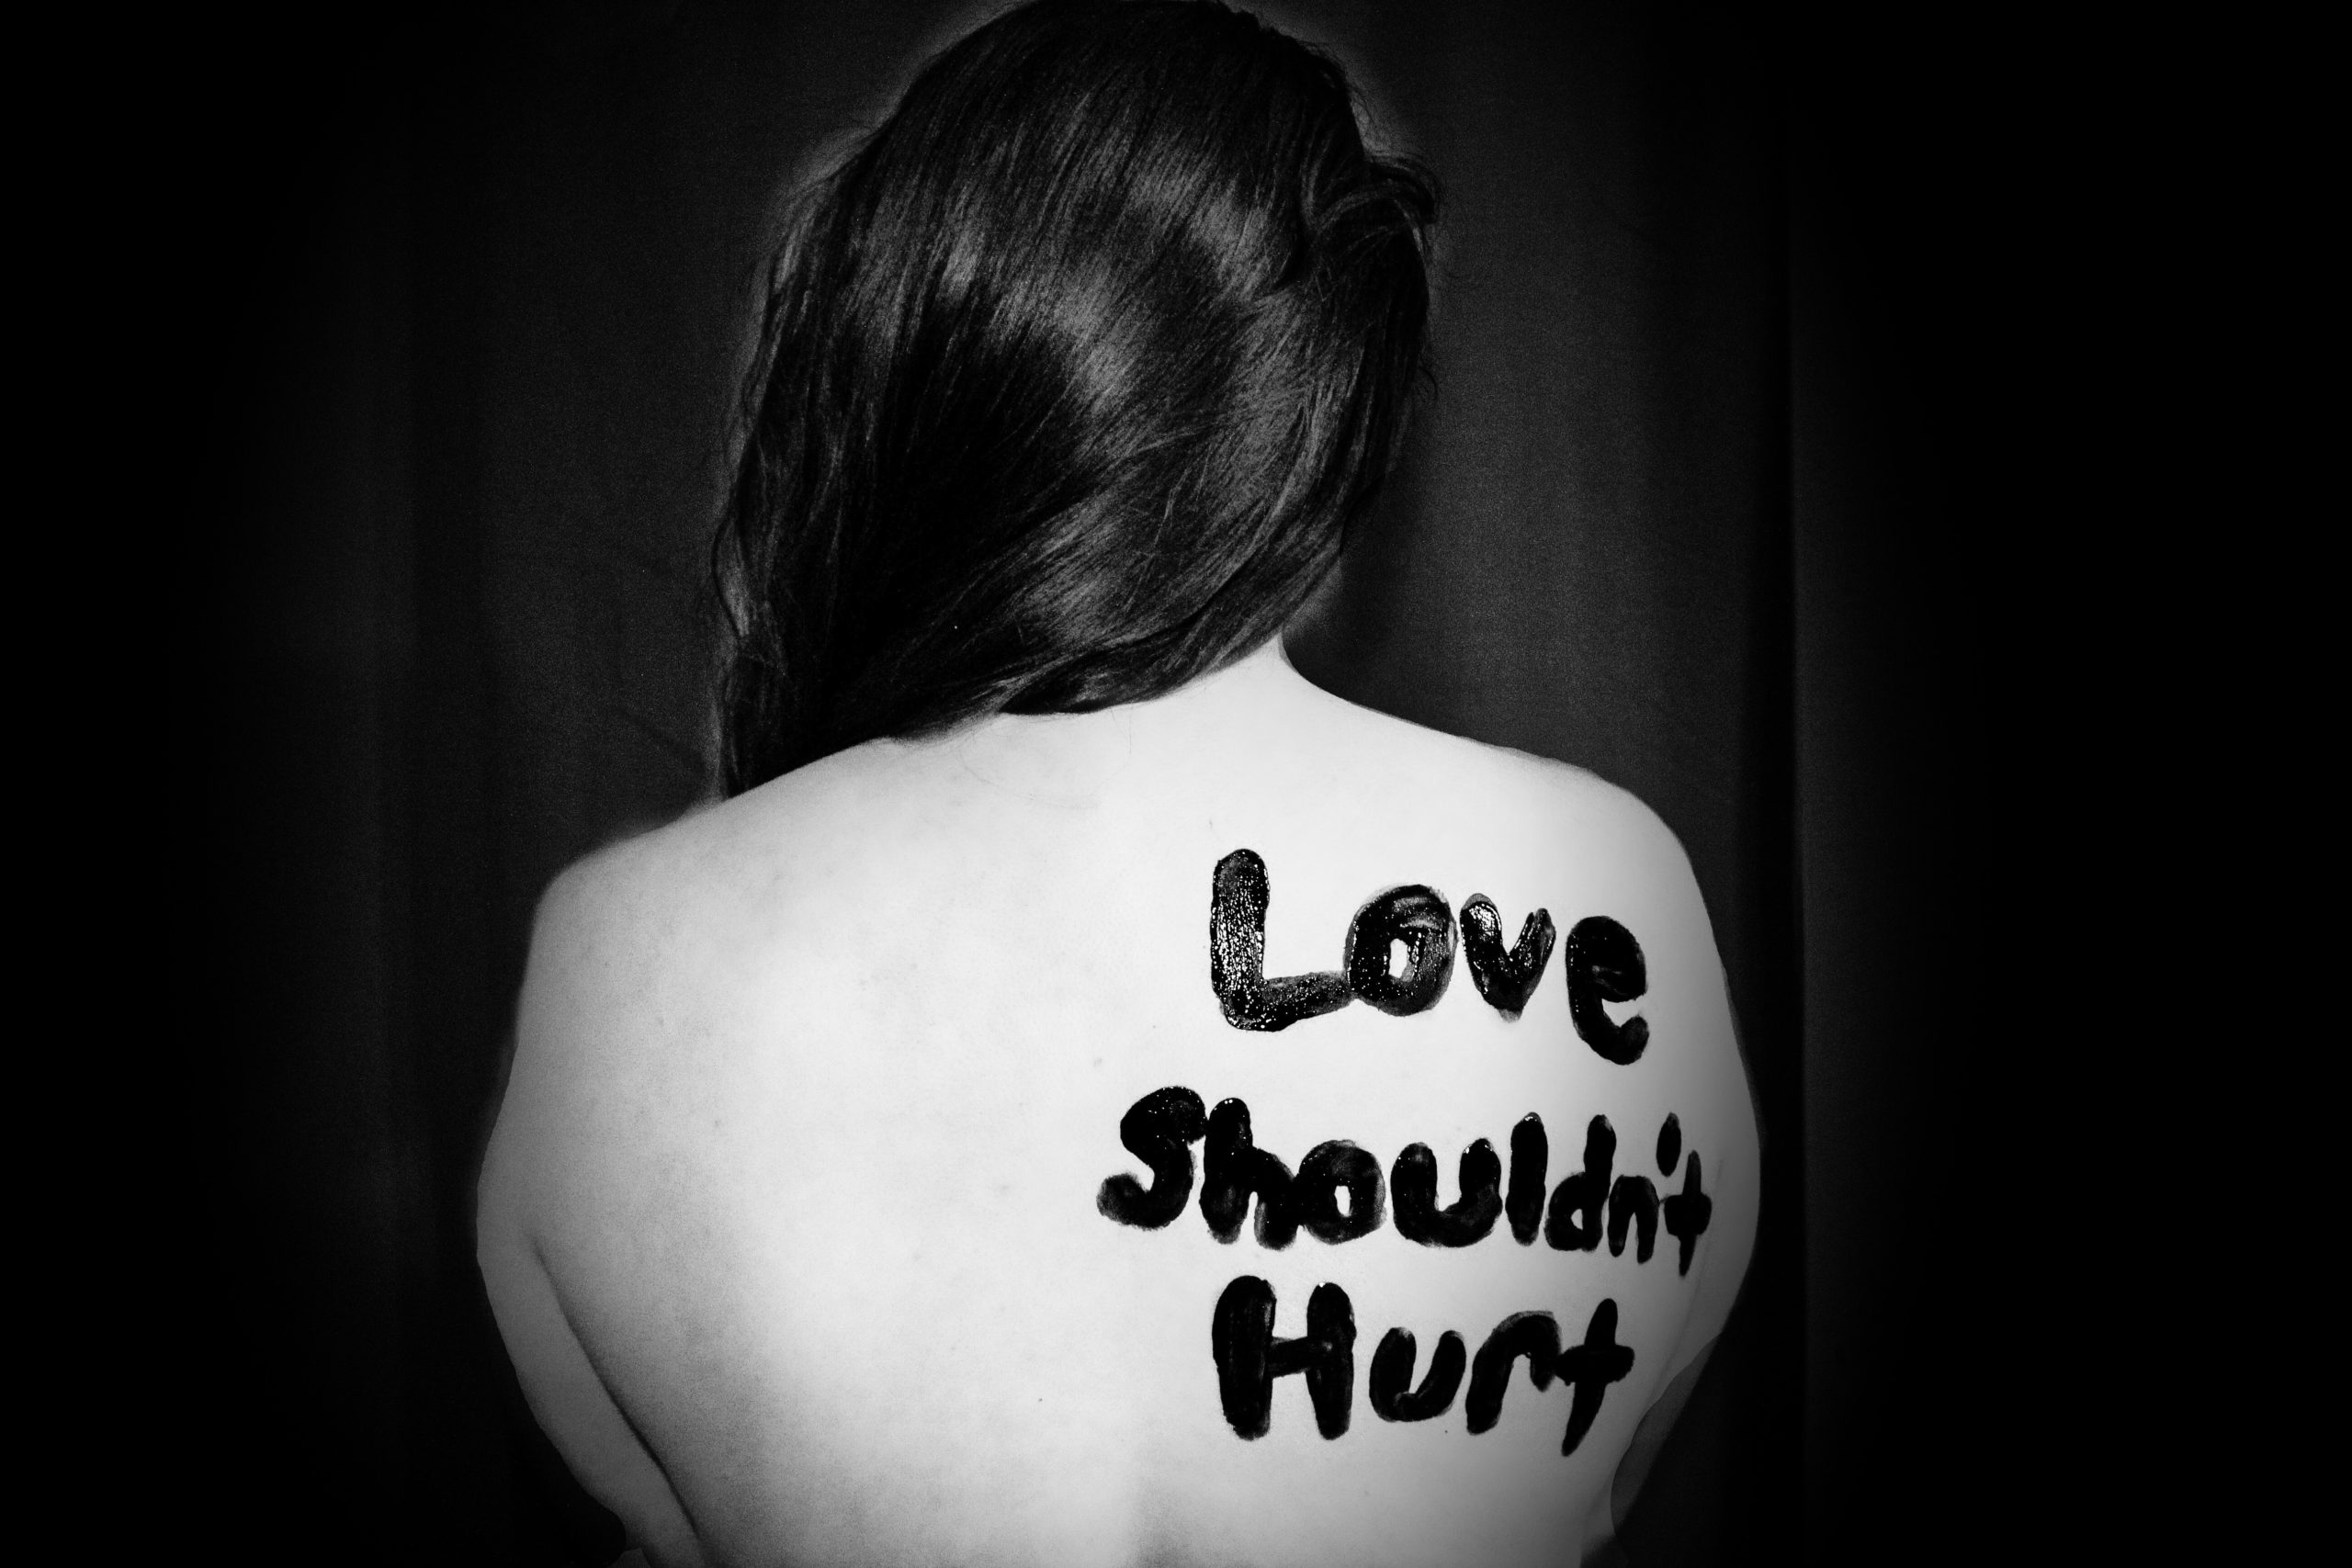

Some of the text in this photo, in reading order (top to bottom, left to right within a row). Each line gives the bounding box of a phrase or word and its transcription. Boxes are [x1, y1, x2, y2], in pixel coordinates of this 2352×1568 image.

[1209, 847, 1649, 1066] Love
[1097, 1086, 1713, 1278] Shouldn't
[1211, 1274, 1636, 1458] Hurt
